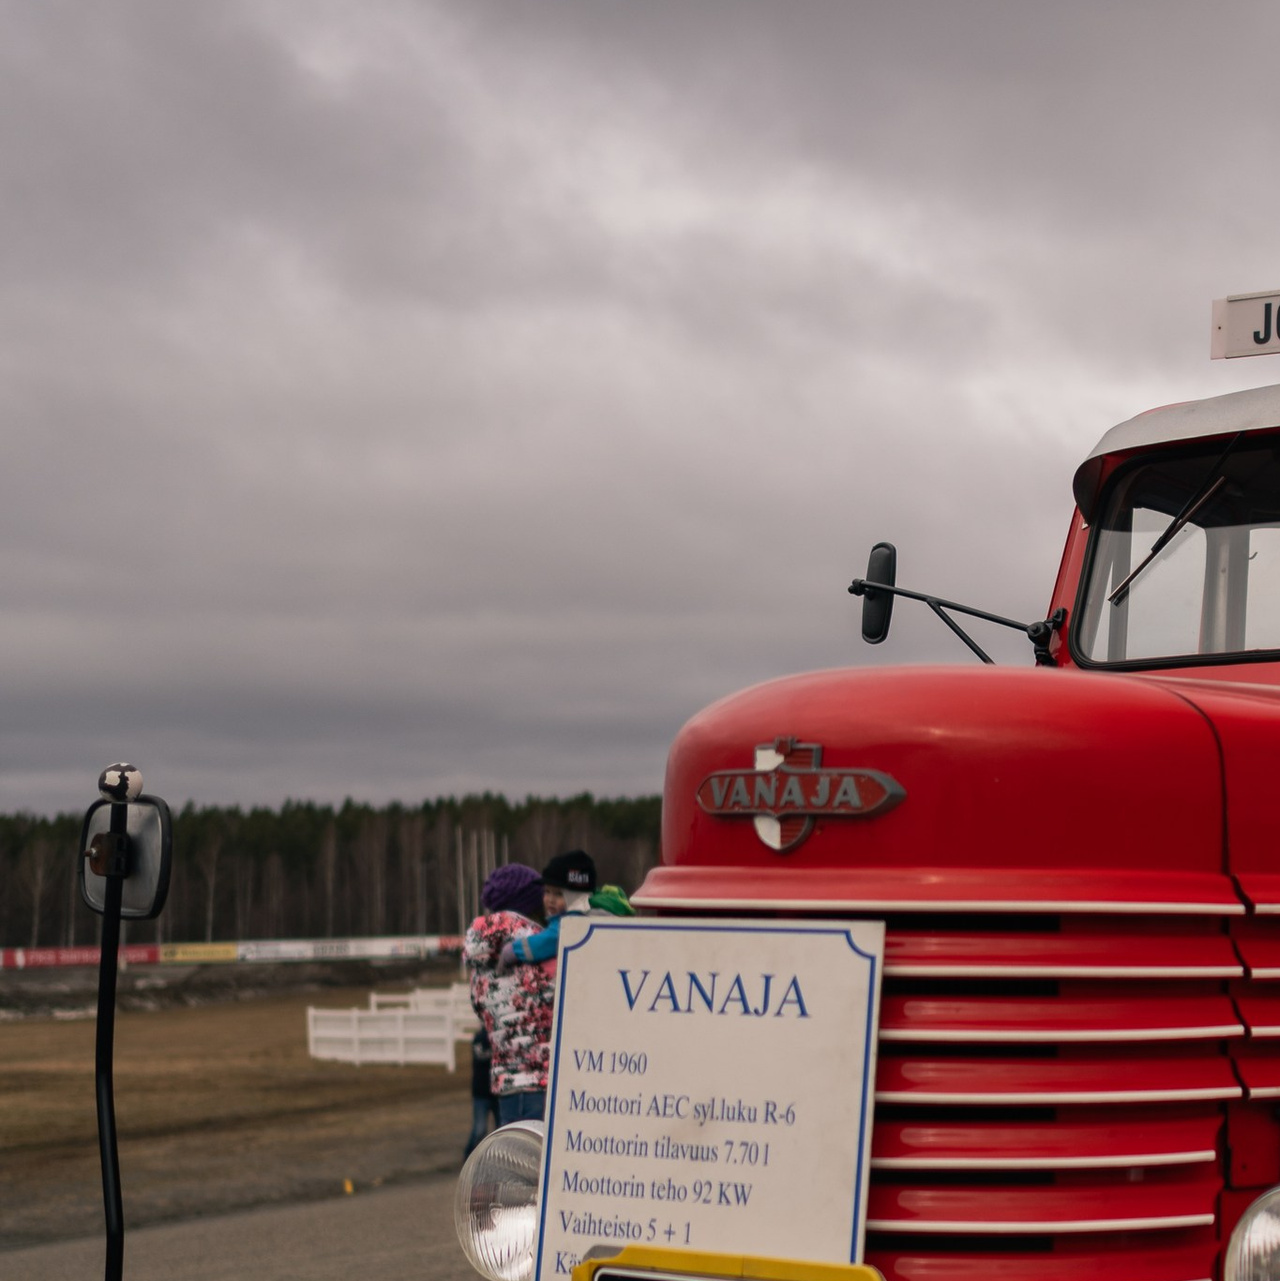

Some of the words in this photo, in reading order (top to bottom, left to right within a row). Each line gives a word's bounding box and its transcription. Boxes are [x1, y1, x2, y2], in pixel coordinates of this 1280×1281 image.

[710, 775, 863, 808] VANAJA
[617, 968, 811, 1019] VANAJA
[573, 1049, 604, 1073] VM
[611, 1052, 648, 1075] 1960
[569, 1089, 642, 1116] Moottori
[646, 1094, 690, 1120] AEC
[693, 1098, 758, 1127] syl.luku
[763, 1101, 796, 1126] R-6
[565, 1129, 649, 1159] Moottorin
[654, 1136, 719, 1164] tilavuus
[562, 1170, 646, 1199] Moottorin
[651, 1178, 688, 1203] teho
[693, 1180, 713, 1205] 92
[717, 1181, 754, 1207] KW
[560, 1210, 643, 1241] Vaihteisto
[646, 1218, 658, 1242] 5
[684, 1222, 692, 1245] 1
